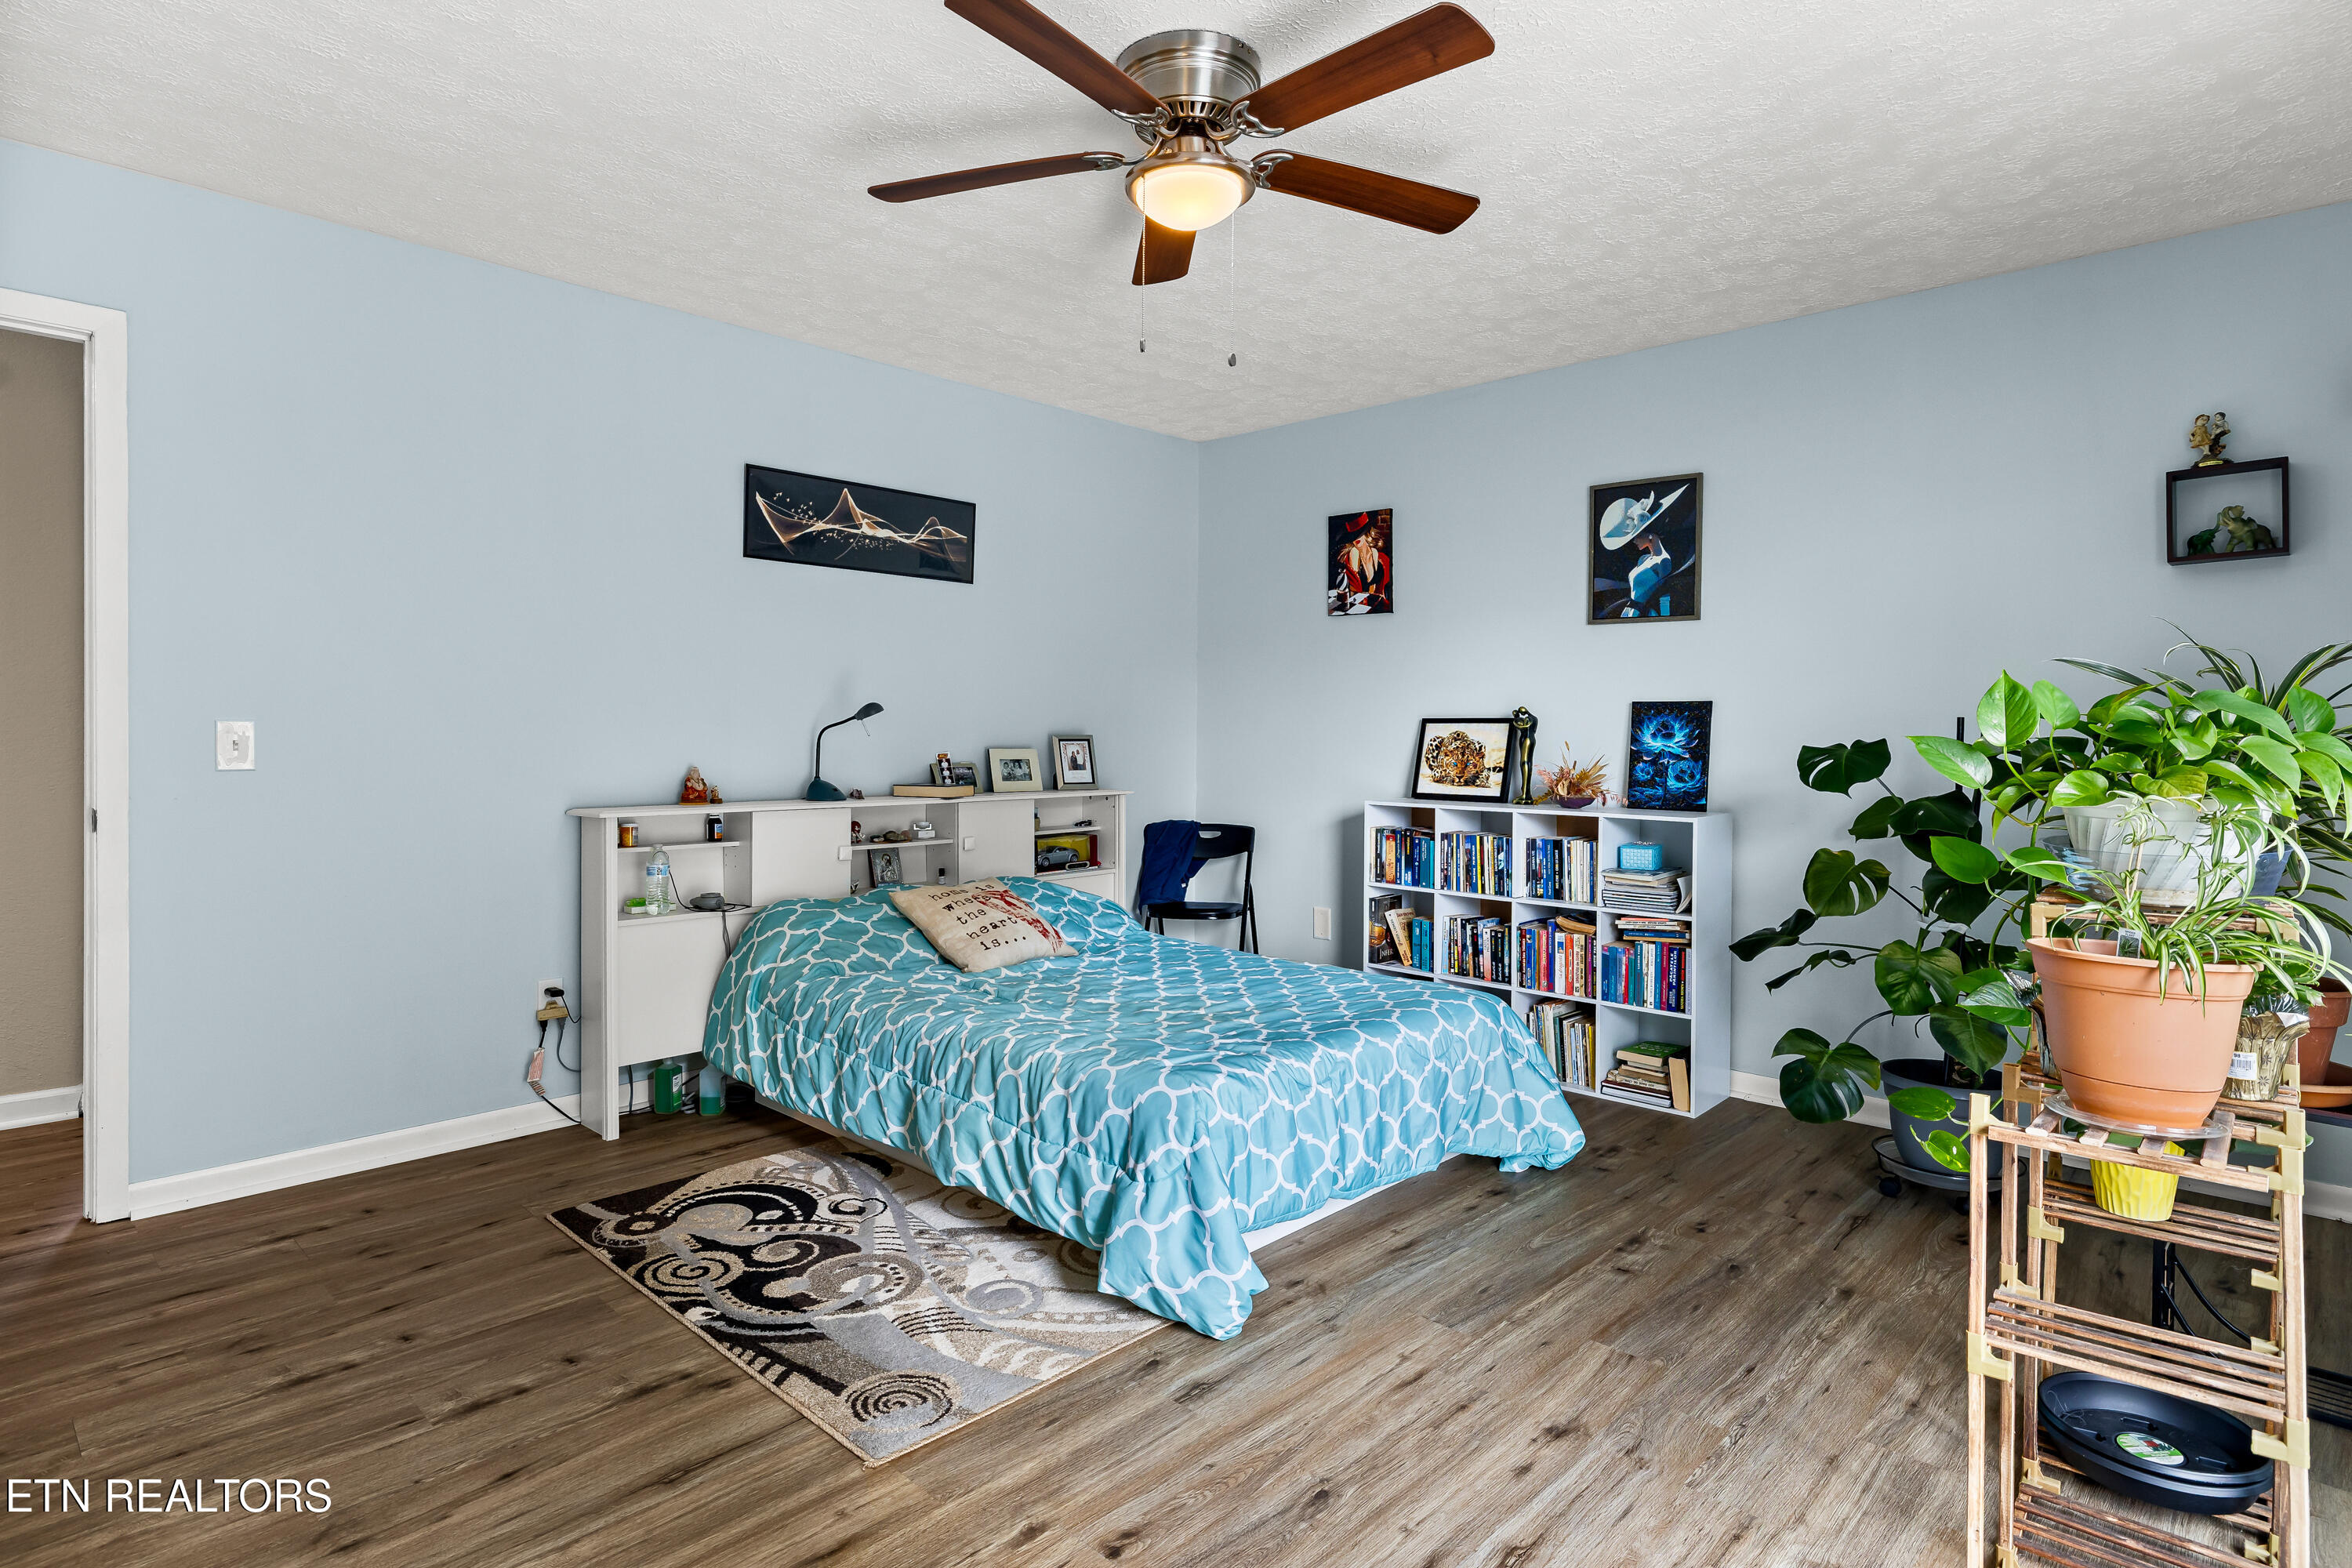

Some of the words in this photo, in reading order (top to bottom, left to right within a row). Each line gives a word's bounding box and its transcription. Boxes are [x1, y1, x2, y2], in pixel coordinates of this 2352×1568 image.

[928, 889, 969, 901] home
[942, 895, 992, 912] where
[956, 909, 987, 924] the
[966, 916, 1018, 939] heart
[979, 936, 1026, 951] is...
